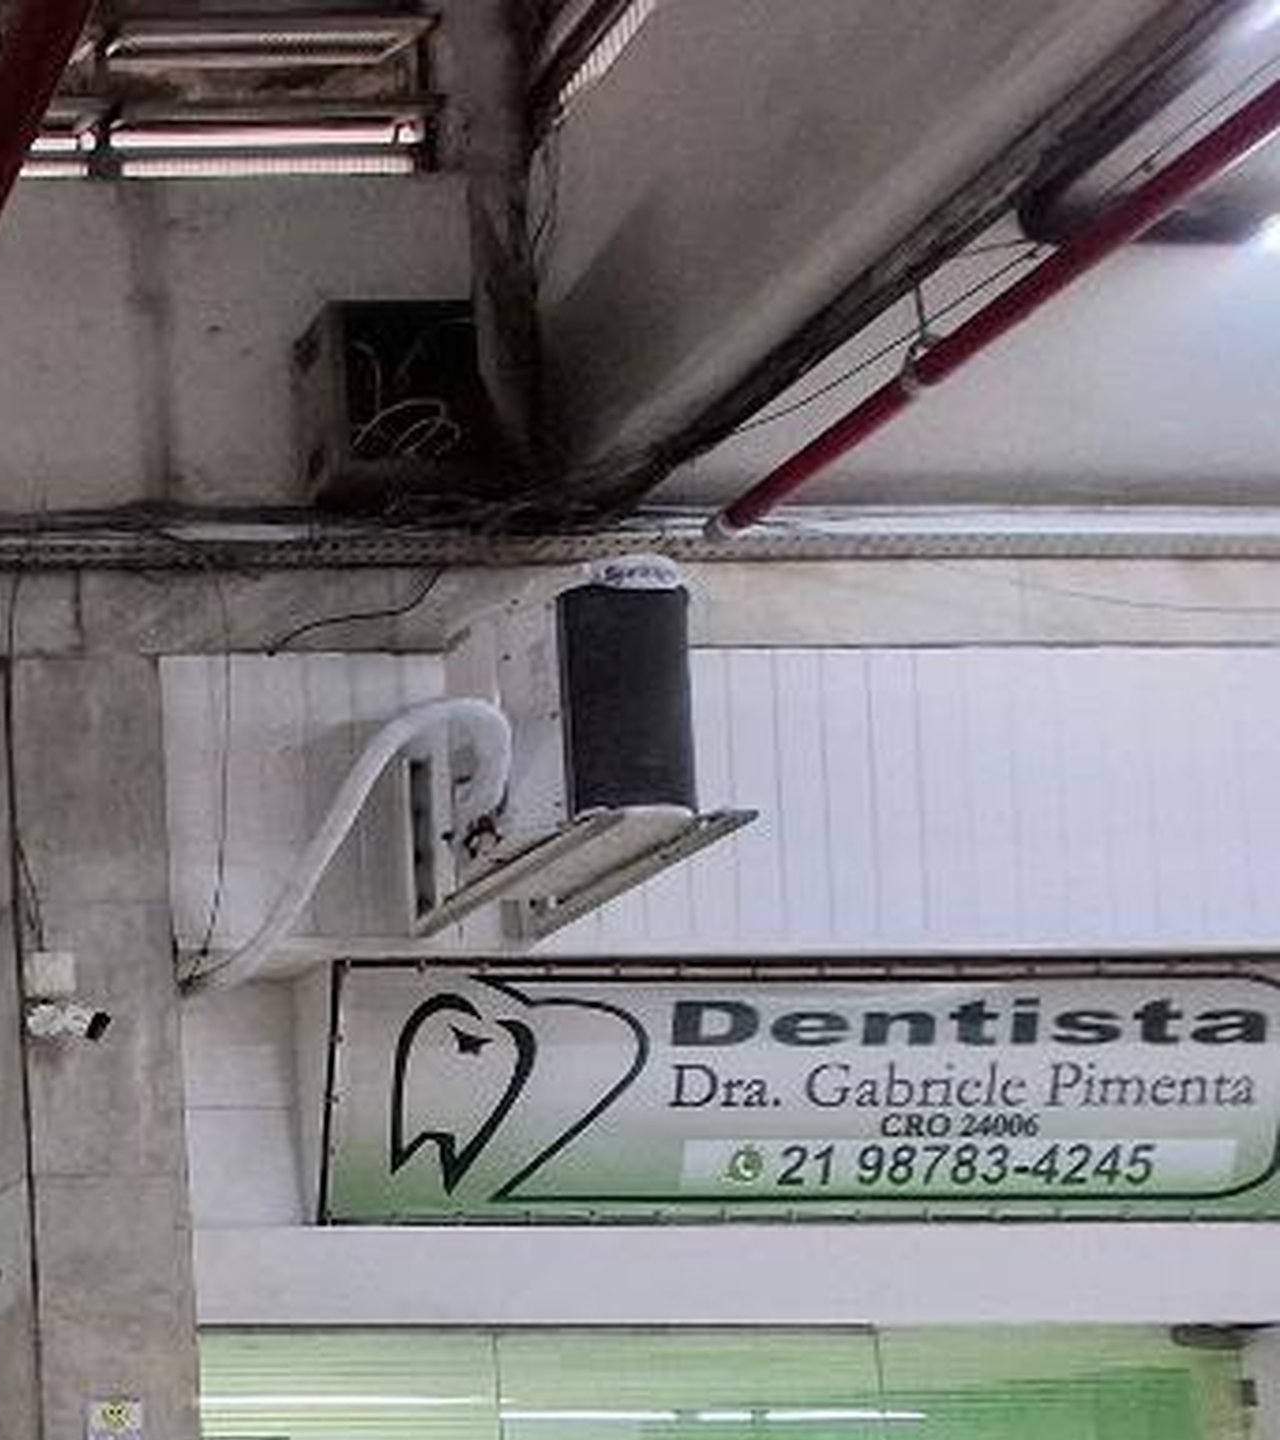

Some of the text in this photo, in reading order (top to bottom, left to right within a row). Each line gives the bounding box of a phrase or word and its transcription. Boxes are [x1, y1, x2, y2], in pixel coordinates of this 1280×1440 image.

[671, 998, 1267, 1046] Dentista
[669, 1060, 1256, 1107] Dra. Gabriele Pimenta
[880, 1112, 1040, 1138] CRO 24006
[776, 1143, 1157, 1186] 21 98783-4245
